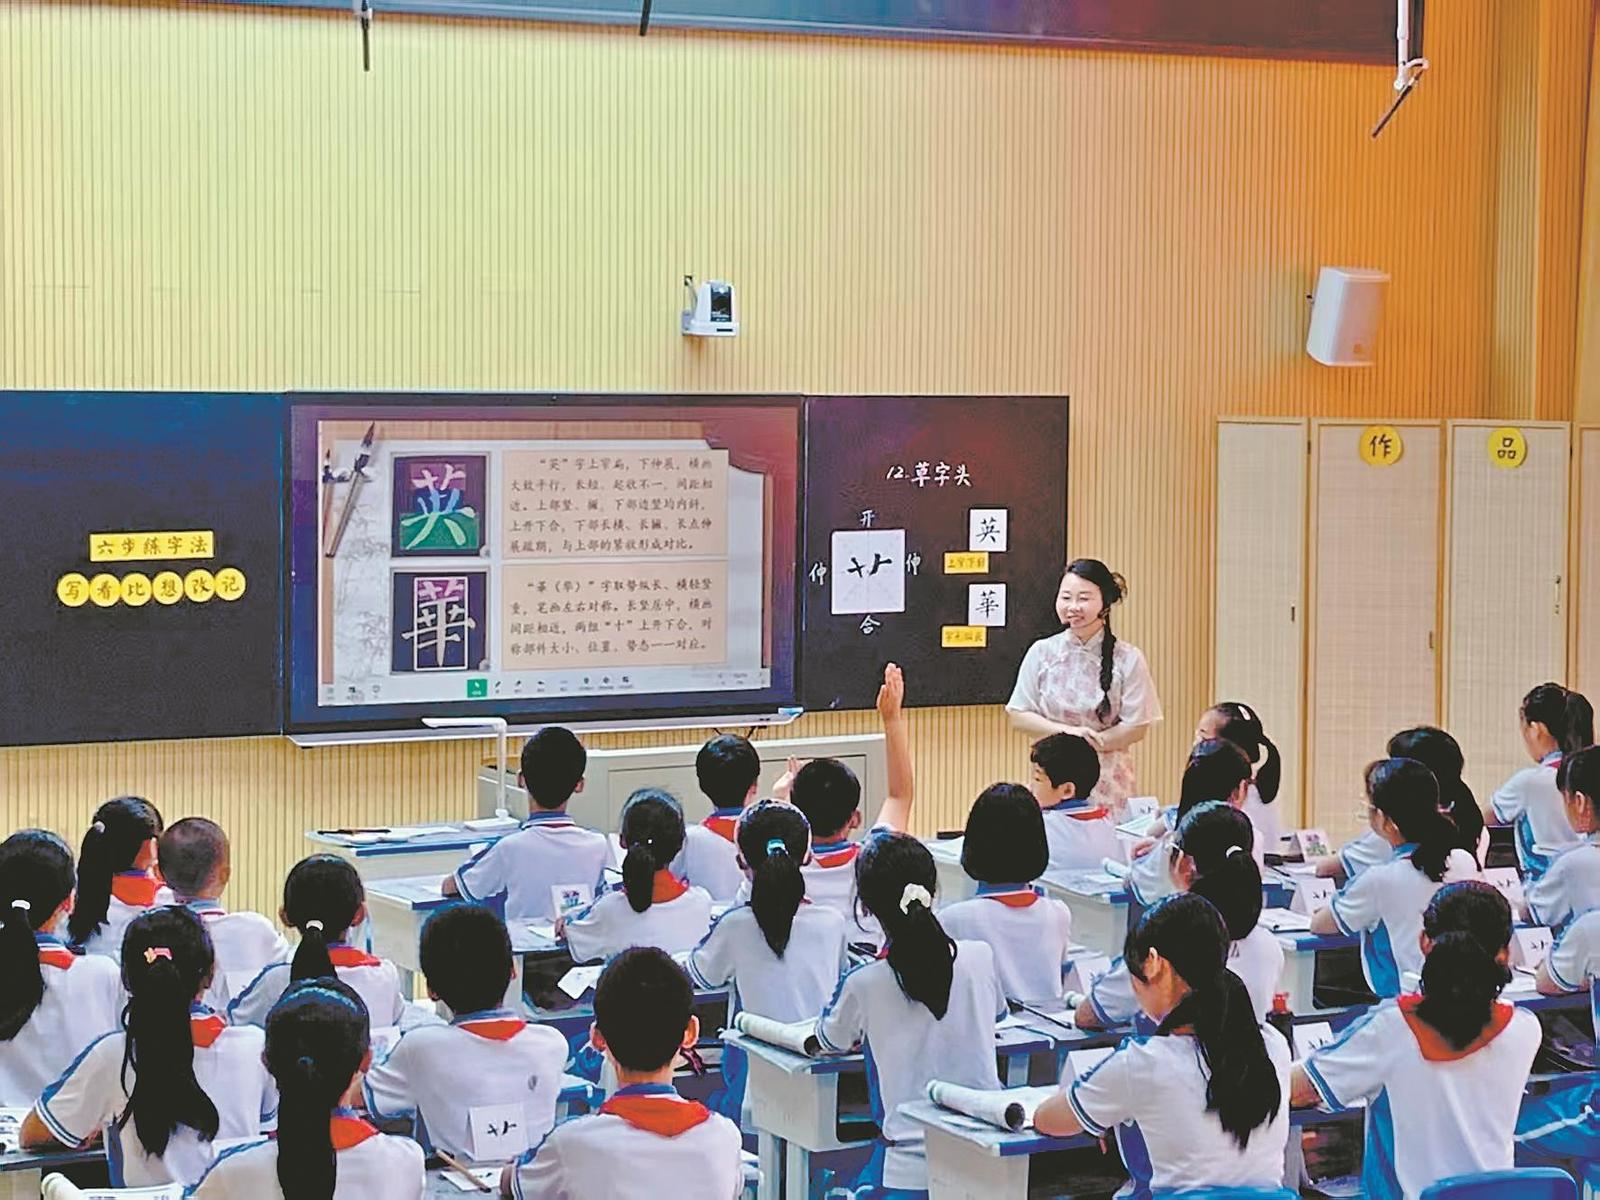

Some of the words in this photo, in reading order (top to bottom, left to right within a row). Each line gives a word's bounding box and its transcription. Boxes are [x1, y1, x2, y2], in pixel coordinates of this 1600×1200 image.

[1369, 433, 1393, 459] 作
[1497, 436, 1517, 459] 品
[886, 461, 972, 487] 12.草字头
[400, 463, 477, 550] 英
[859, 509, 876, 527] 开
[975, 516, 1000, 543] 英
[96, 535, 209, 556] 六步练字法
[808, 561, 828, 586] 伸
[974, 589, 1000, 619] 華
[400, 577, 477, 667] 華
[859, 615, 882, 634] 合
